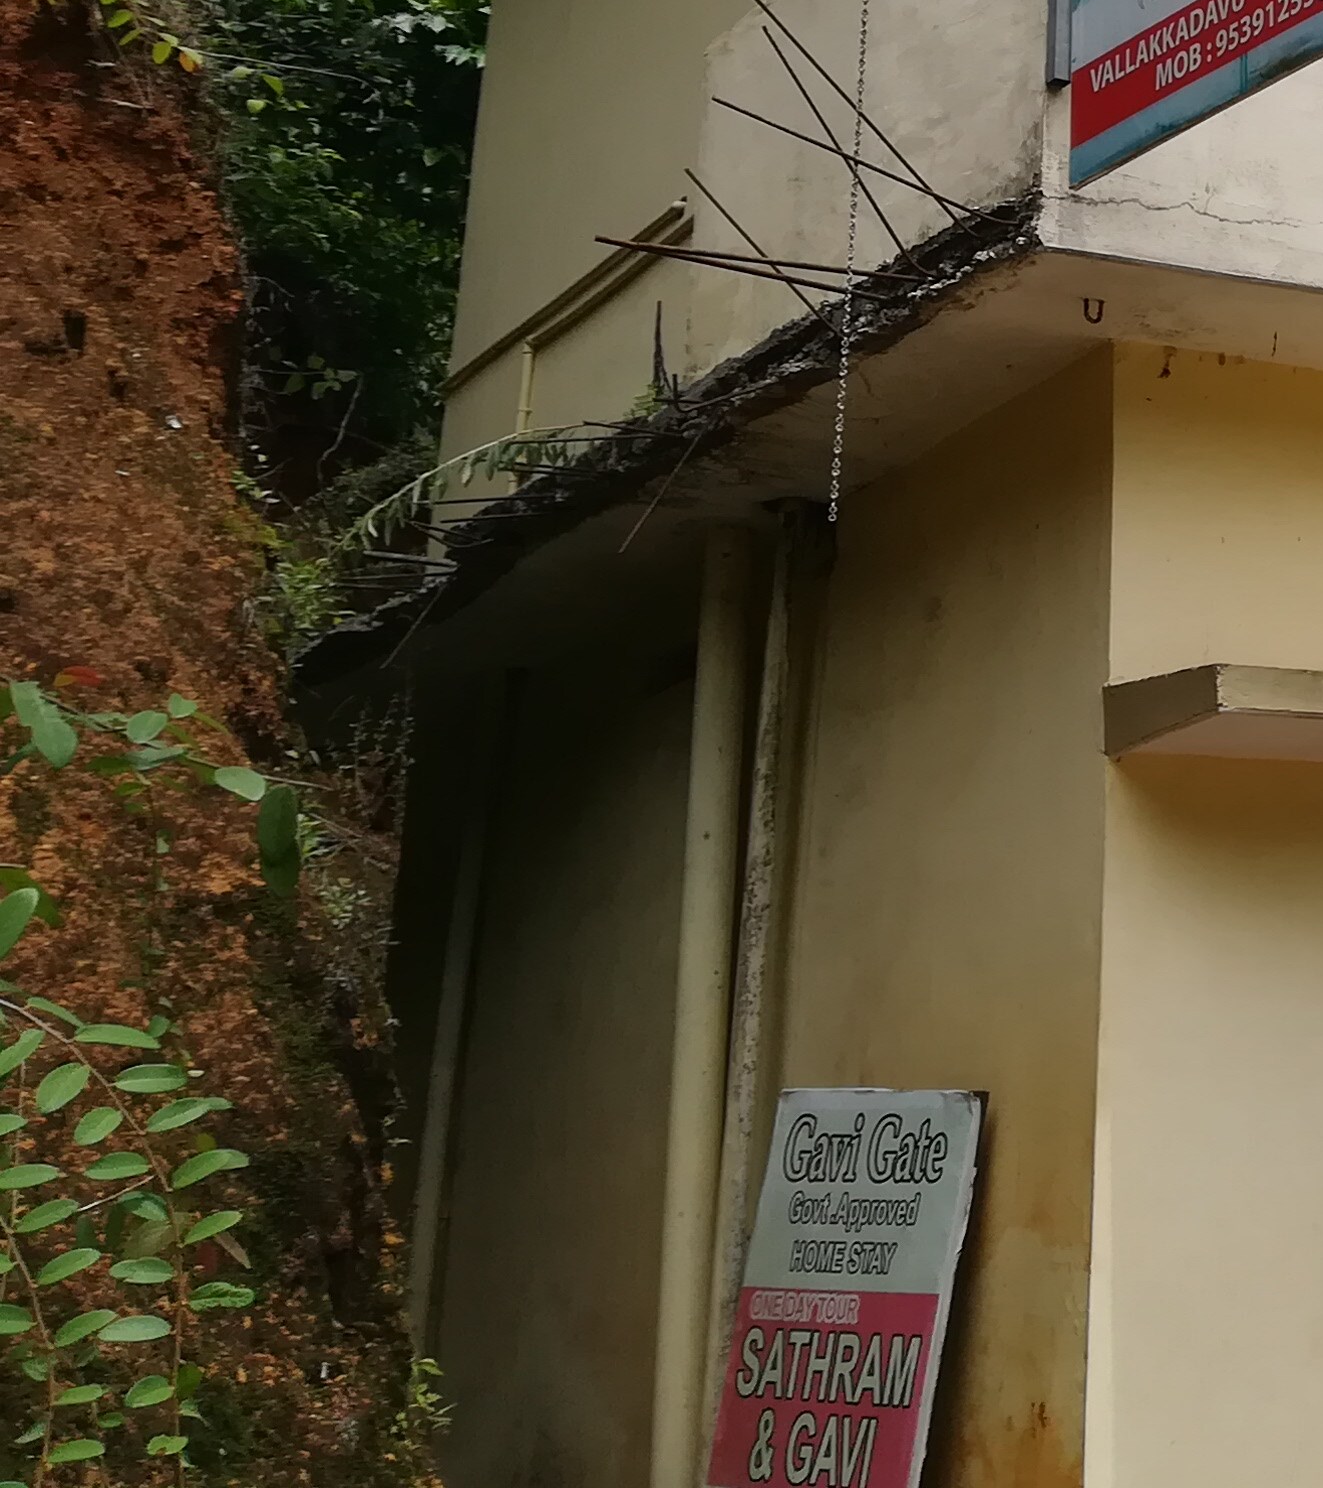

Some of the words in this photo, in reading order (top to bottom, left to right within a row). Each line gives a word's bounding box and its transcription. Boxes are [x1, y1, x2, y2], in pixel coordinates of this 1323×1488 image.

[1155, 42, 1202, 91] MOB
[783, 1112, 865, 1183] Gavi
[867, 1113, 948, 1184] Gate
[789, 1240, 847, 1274] HOME
[847, 1241, 898, 1275] STAY
[751, 1291, 784, 1320] ONE
[783, 1291, 816, 1323] DAY
[816, 1293, 860, 1324] TOUR
[736, 1326, 922, 1408] SATHRAM
[749, 1407, 775, 1483] &
[786, 1410, 879, 1488] GAVI
